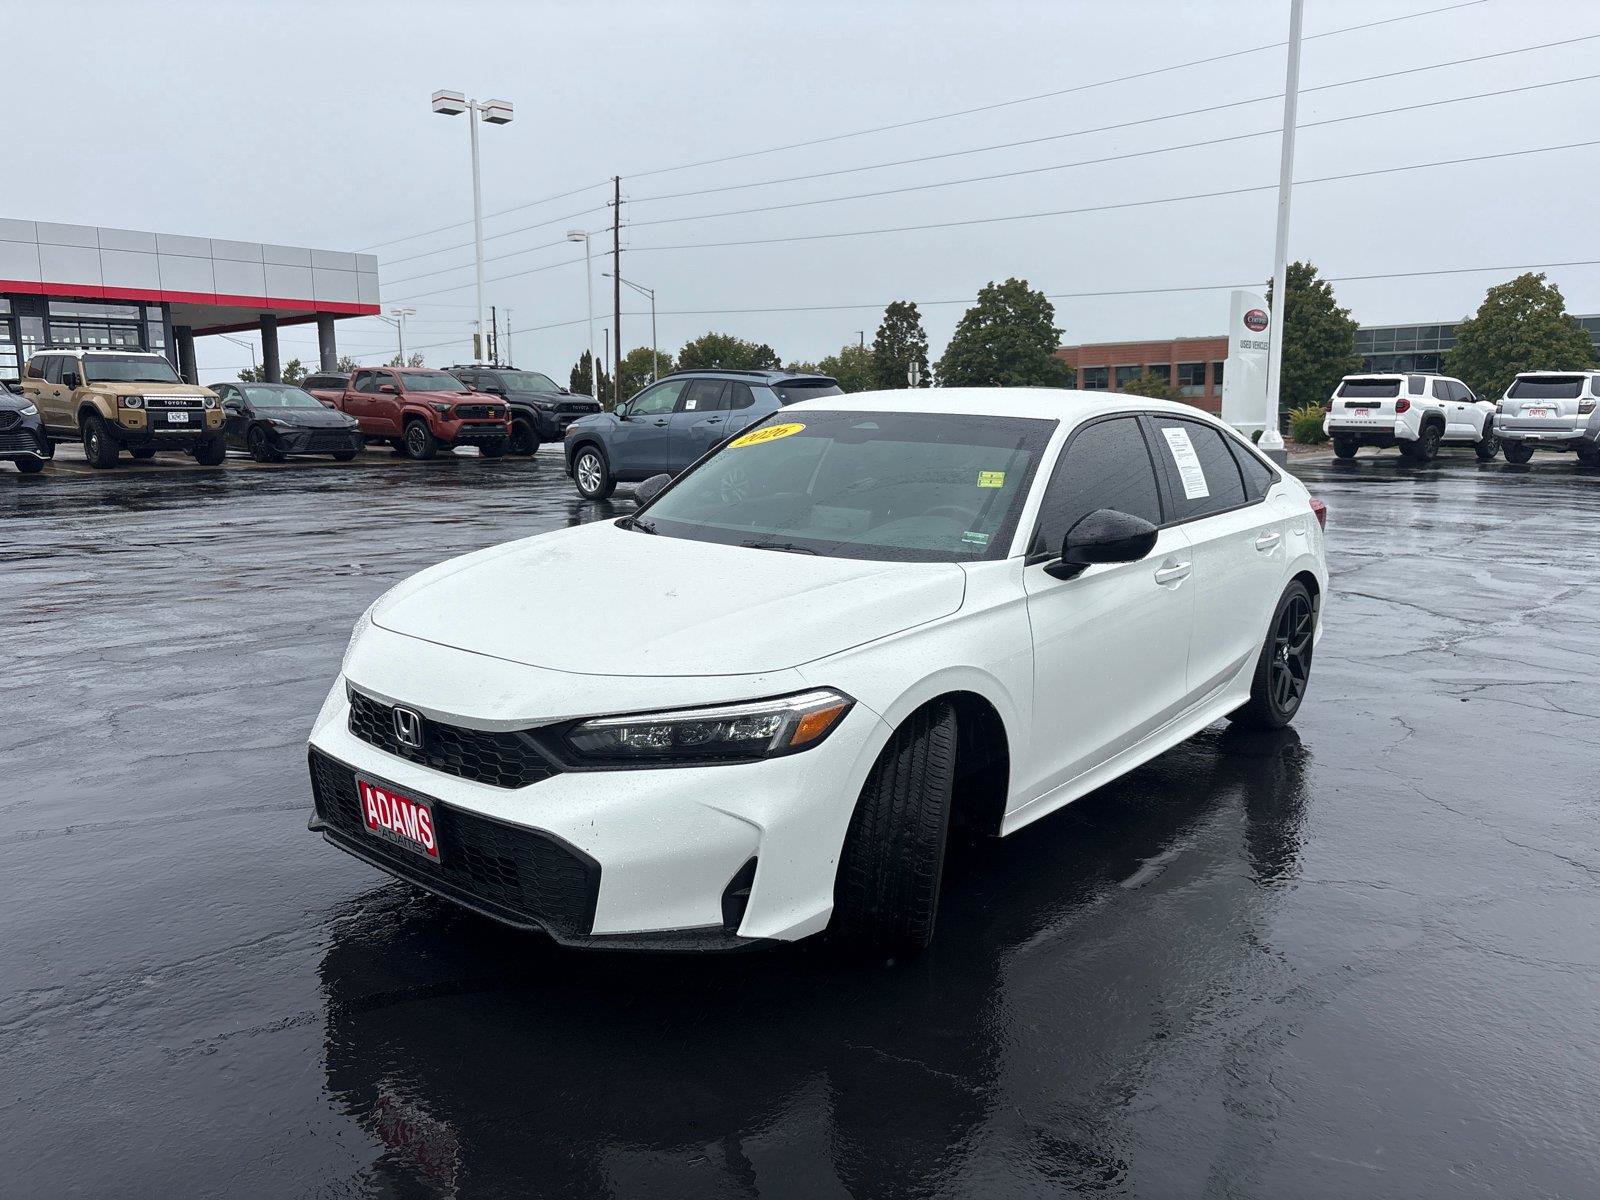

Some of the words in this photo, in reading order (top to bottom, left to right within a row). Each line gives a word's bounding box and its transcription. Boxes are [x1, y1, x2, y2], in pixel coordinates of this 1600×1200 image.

[1240, 340, 1251, 349] USED
[735, 425, 797, 446] 2026
[366, 787, 434, 849] ADAMS
